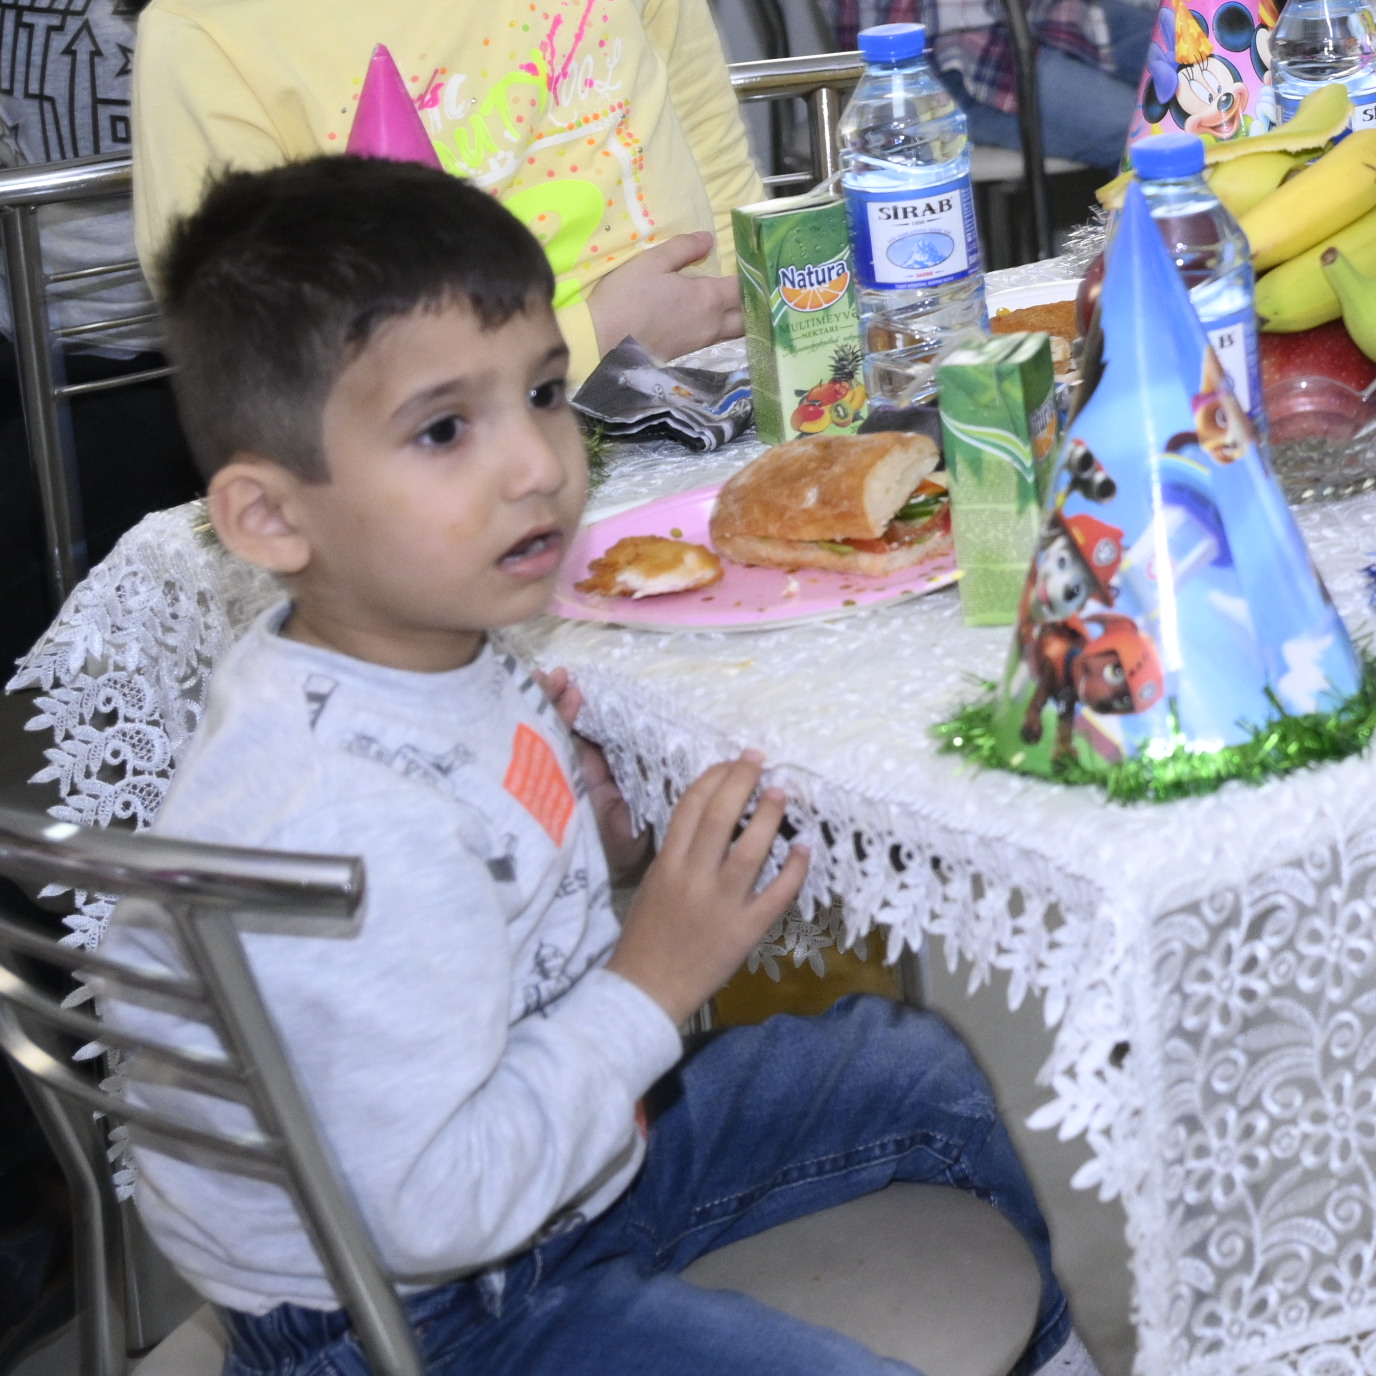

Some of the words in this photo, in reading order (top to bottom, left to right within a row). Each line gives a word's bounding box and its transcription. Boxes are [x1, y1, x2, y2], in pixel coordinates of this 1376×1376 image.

[878, 198, 953, 221] SİRAB
[779, 261, 847, 290] Natura
[801, 326, 839, 339] NEKTARI
